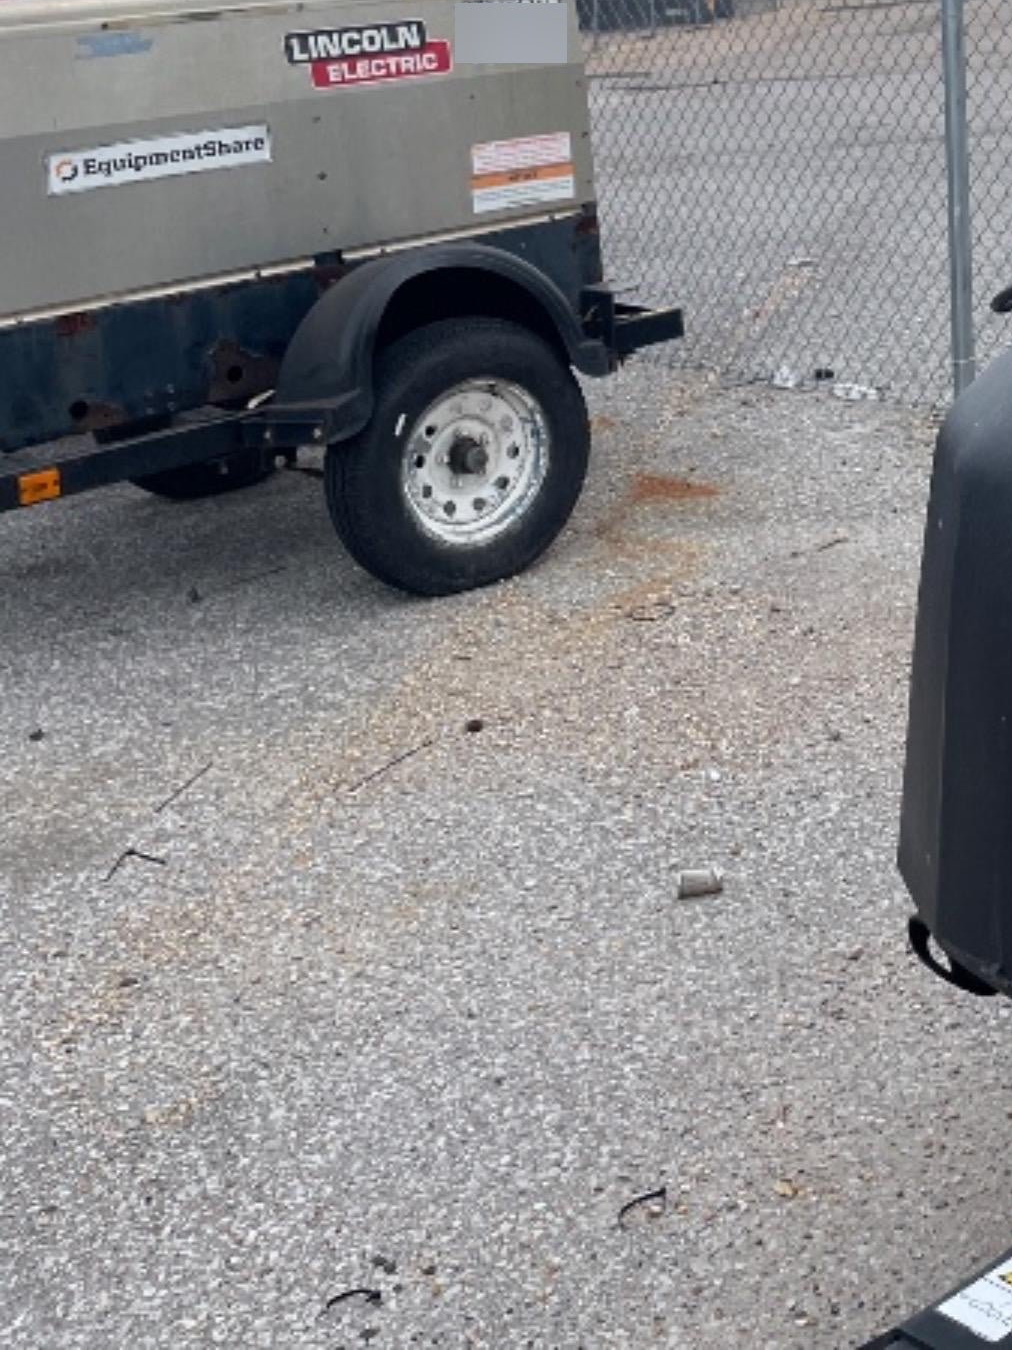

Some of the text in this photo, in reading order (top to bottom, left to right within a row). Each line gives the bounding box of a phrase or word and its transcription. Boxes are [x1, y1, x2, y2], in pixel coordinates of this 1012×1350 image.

[289, 22, 422, 61] LINCOLN
[325, 52, 439, 83] ELECTRIC
[82, 136, 266, 177] EquipmentShare
